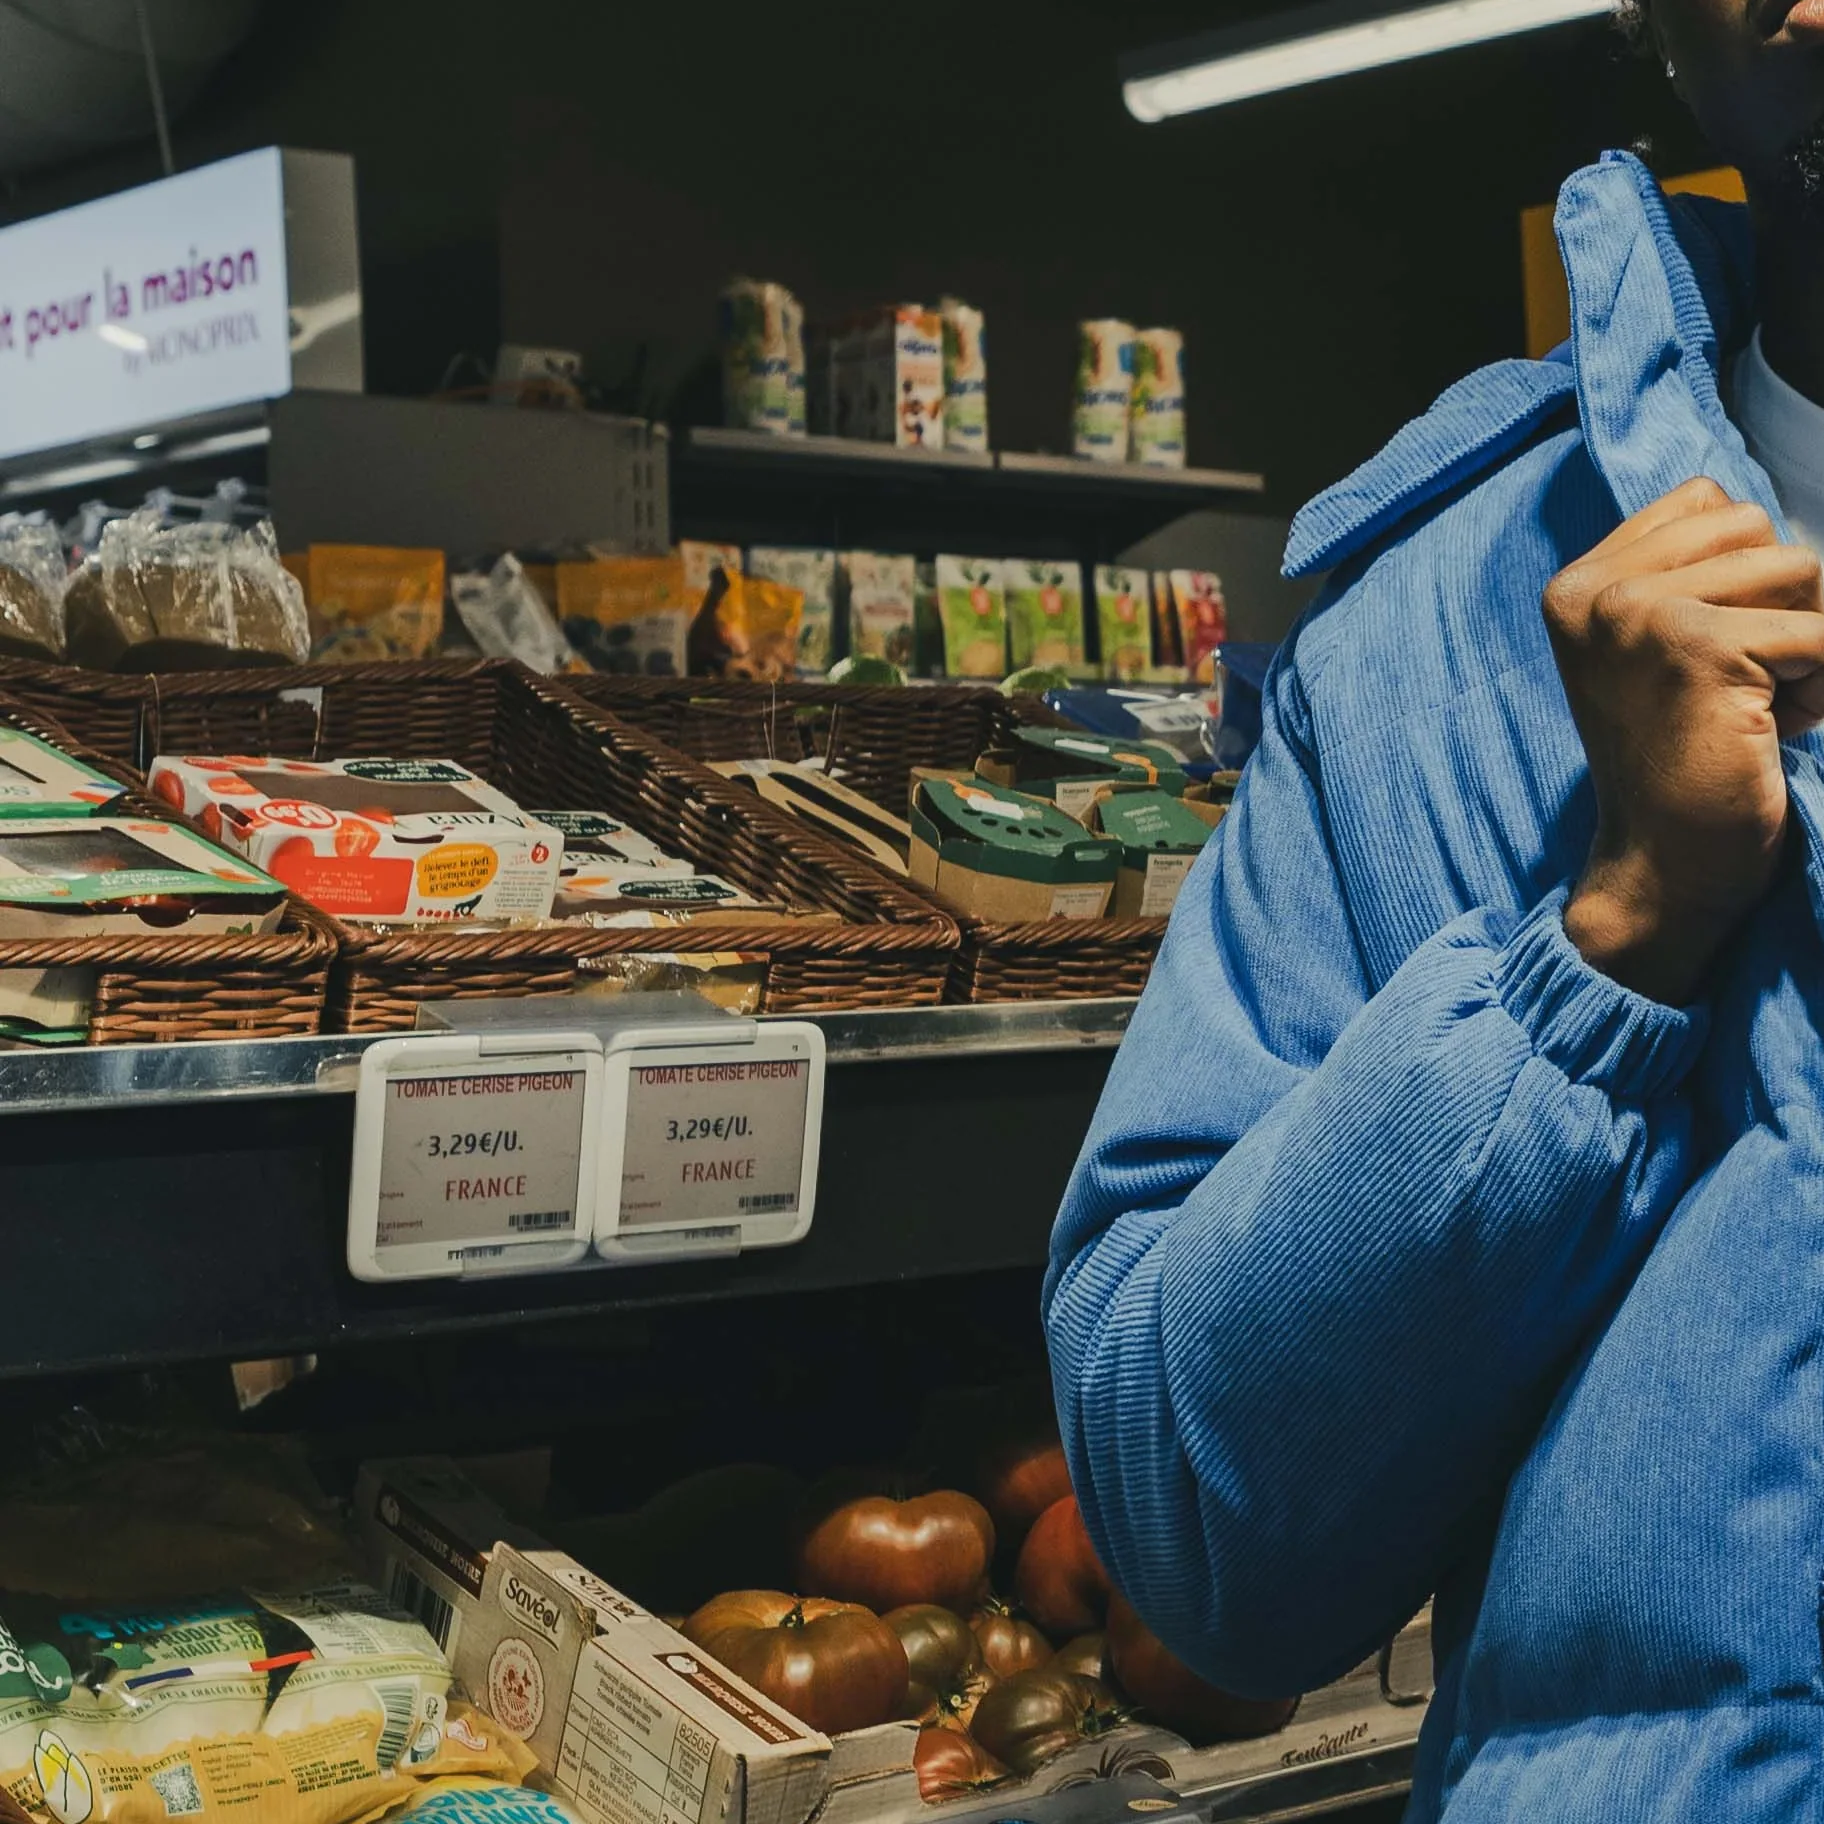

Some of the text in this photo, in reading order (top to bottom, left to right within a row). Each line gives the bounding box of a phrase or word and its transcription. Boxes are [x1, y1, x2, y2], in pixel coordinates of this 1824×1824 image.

[26, 291, 93, 360] pour
[103, 266, 130, 320] la
[143, 247, 257, 313] maison
[536, 846, 545, 862] 2
[396, 1072, 573, 1099] TOMATE CERISE PIGEON
[637, 1061, 798, 1087] TOMATE CERISE PIGEON
[666, 1115, 753, 1142] 3,29€/U.
[427, 1130, 524, 1158] 3,29€/U.
[682, 1158, 756, 1184] FRANCE
[445, 1174, 527, 1202] FRANCE
[505, 1577, 562, 1635] Savéol
[150, 1616, 258, 1650] PRODUCTE
[174, 1636, 230, 1659] HAUTS
[678, 1721, 711, 1758] 82505
